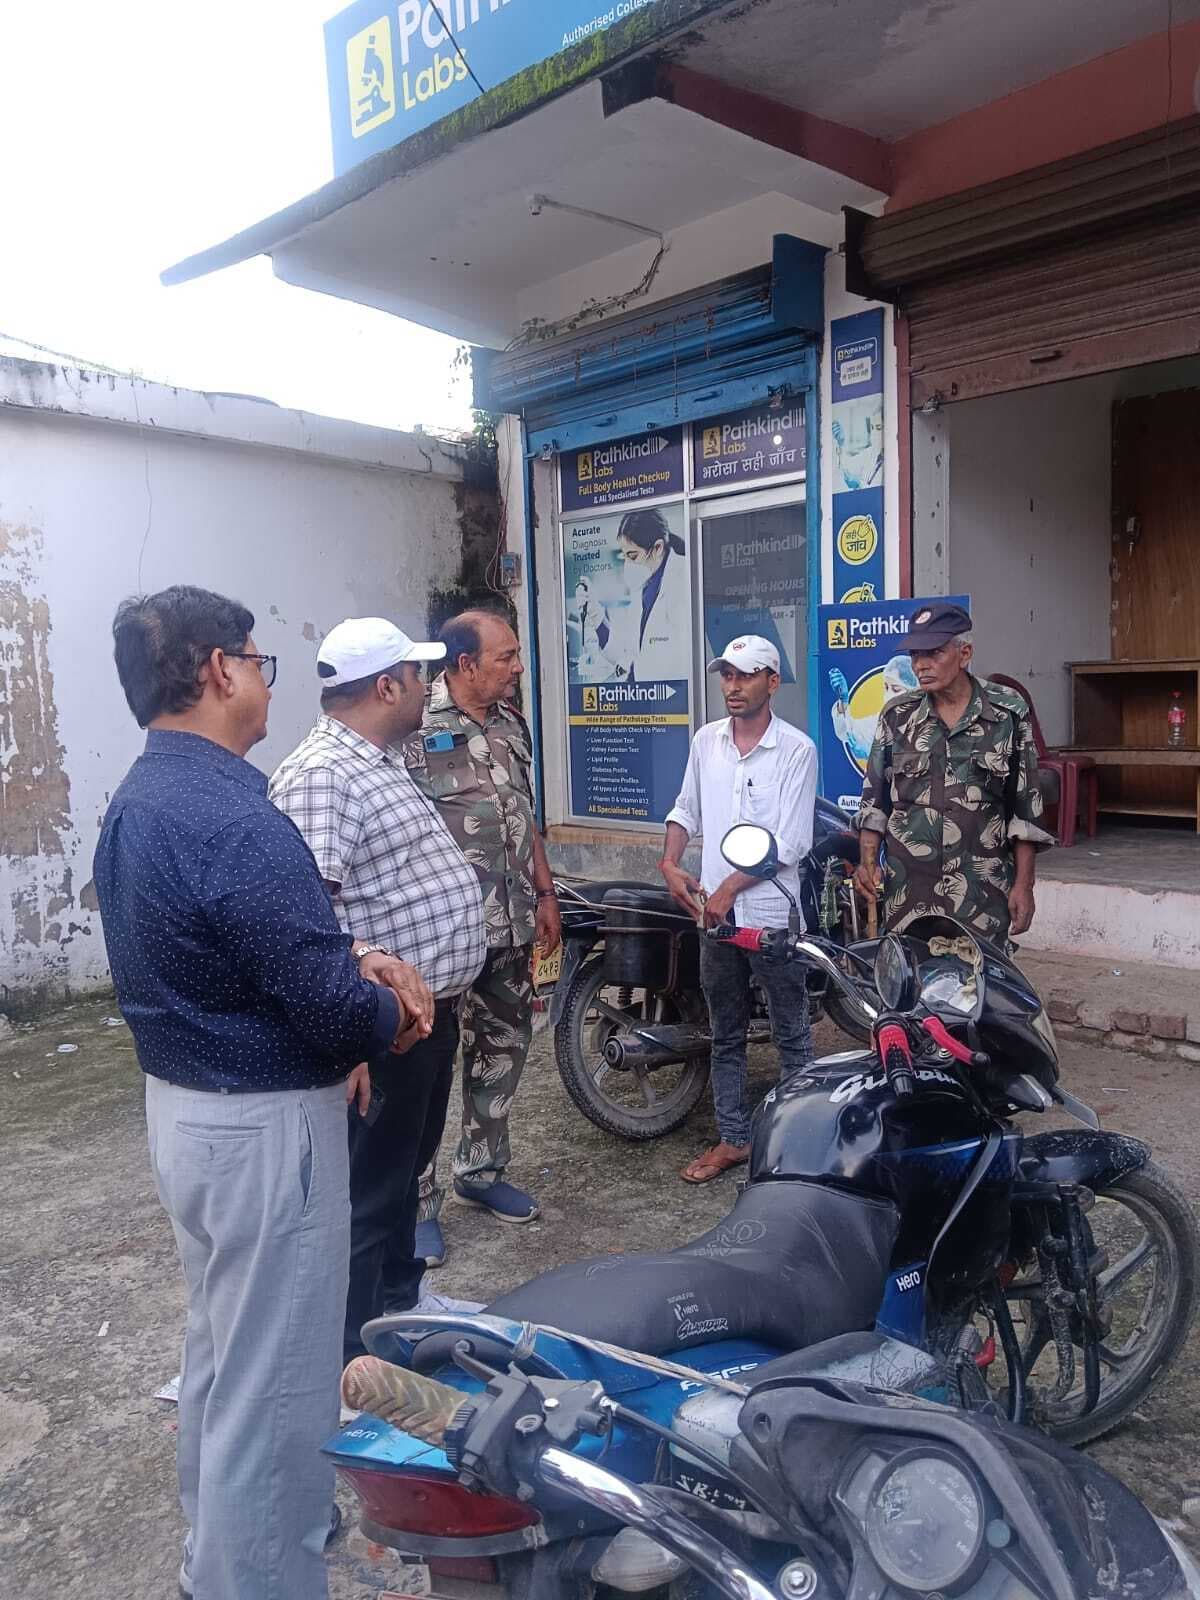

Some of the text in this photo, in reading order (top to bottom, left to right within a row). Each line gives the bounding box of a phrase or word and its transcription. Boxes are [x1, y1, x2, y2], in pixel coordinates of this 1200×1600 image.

[562, 8, 615, 47] Authorised
[402, 48, 468, 110] Labs
[723, 442, 746, 455] Labs
[594, 466, 613, 477] Labs
[703, 460, 738, 478] भरोसा
[741, 451, 765, 471] सही
[578, 471, 670, 496] Full Body Health Checkup
[572, 526, 601, 537] Acurate
[573, 550, 600, 561] Trusted
[850, 614, 910, 636] Pathkin
[850, 637, 877, 648] Labs
[599, 685, 657, 701] Pathkind
[600, 702, 618, 712] Labs
[841, 798, 862, 808] Autho
[896, 1271, 921, 1292] Hero
